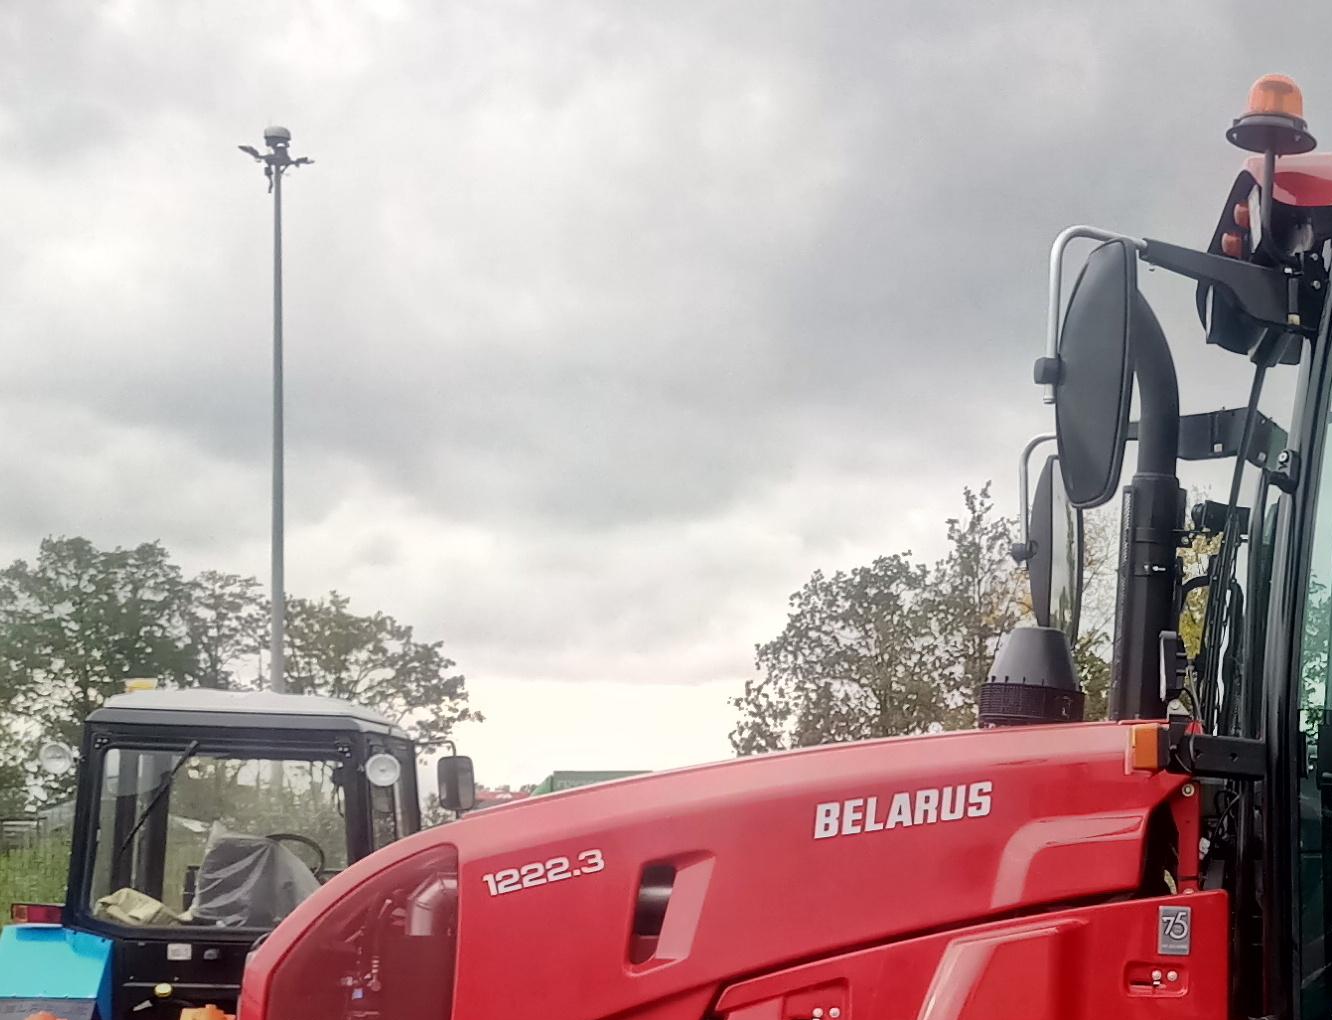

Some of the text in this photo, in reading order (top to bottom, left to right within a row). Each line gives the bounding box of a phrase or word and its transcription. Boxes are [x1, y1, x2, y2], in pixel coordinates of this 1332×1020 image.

[813, 780, 993, 840] BELARUS
[482, 848, 605, 897] 1222.3
[1161, 911, 1188, 939] 75
